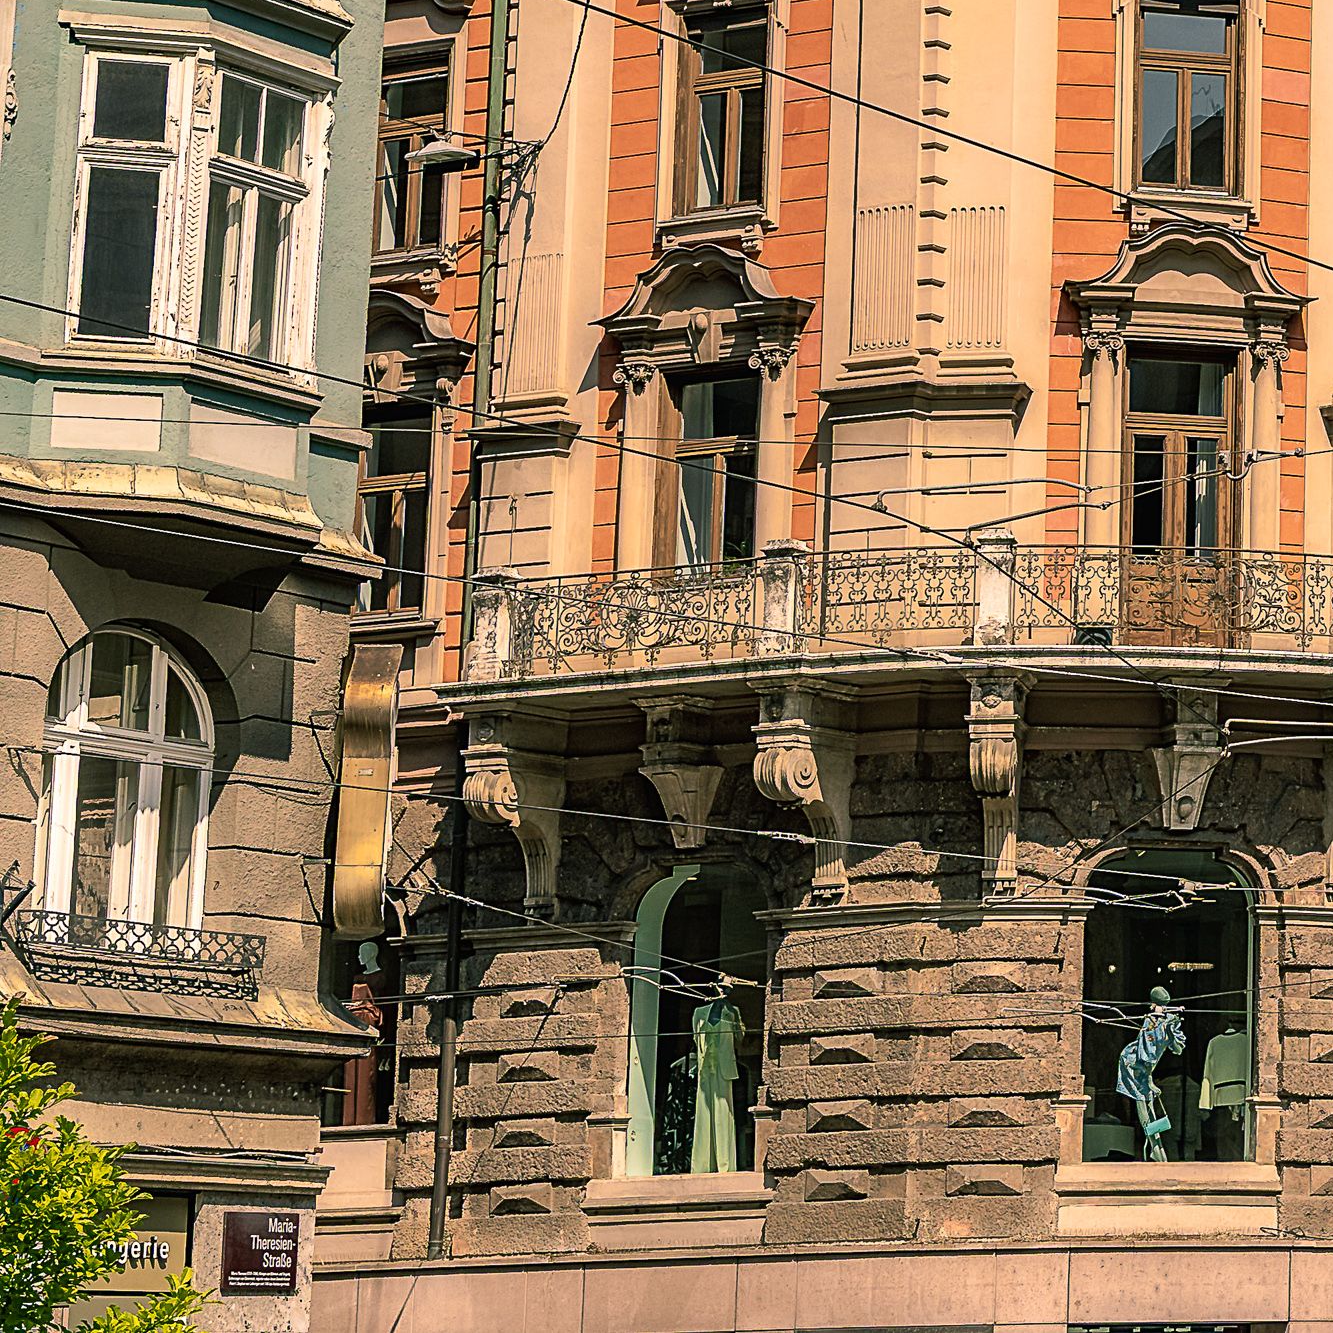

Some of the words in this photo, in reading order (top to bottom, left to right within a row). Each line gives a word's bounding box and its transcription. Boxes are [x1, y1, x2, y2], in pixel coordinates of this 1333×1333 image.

[268, 1217, 297, 1233] Maria-
[250, 1234, 297, 1251] Theresien-
[262, 1251, 292, 1268] Straße
